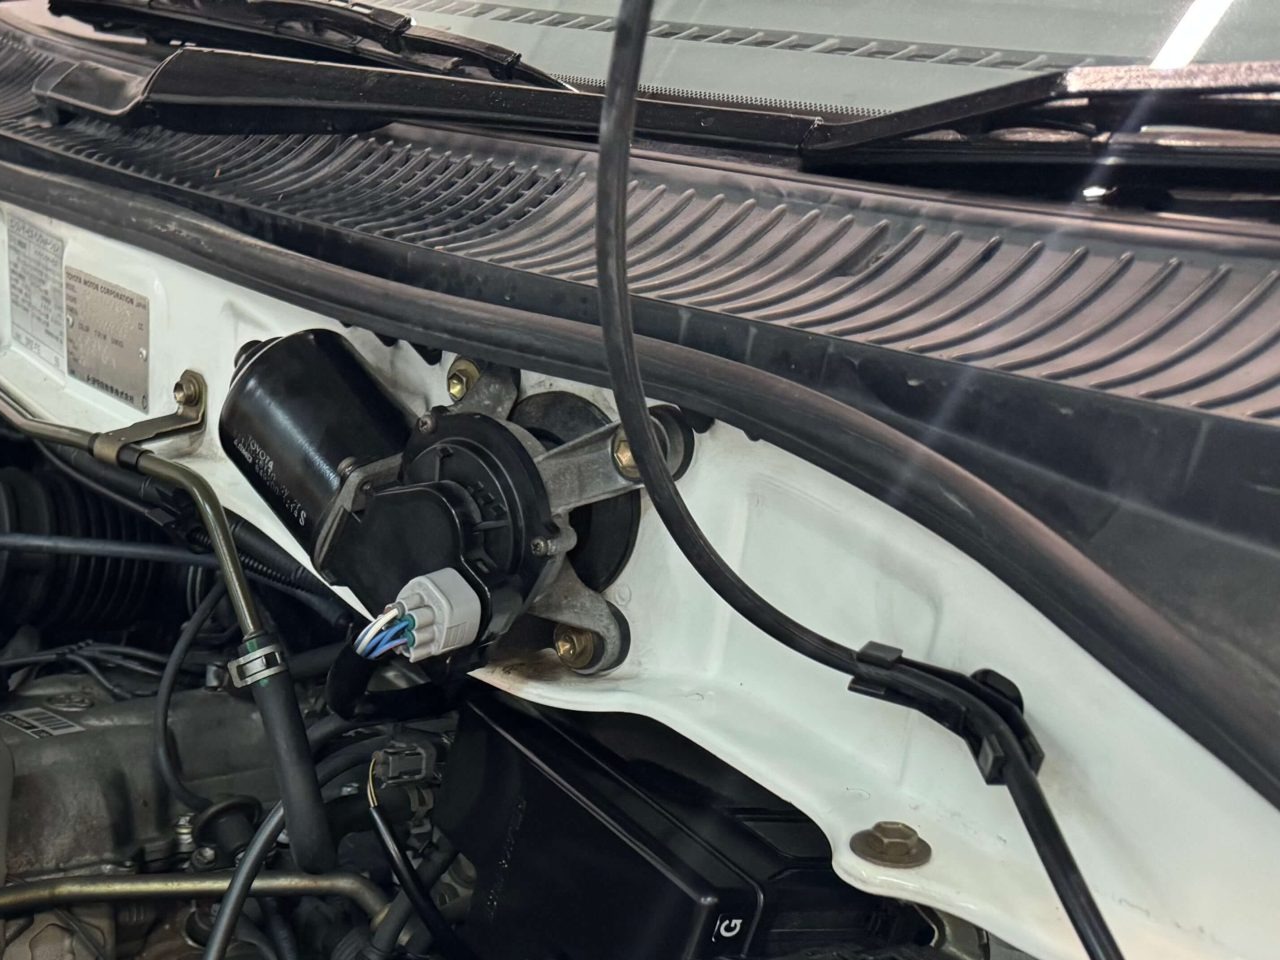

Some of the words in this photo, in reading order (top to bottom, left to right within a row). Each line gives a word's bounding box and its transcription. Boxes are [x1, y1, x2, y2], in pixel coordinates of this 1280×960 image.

[83, 279, 100, 291] MOTOR
[246, 435, 275, 469] TOYOTA
[720, 918, 742, 937] G
